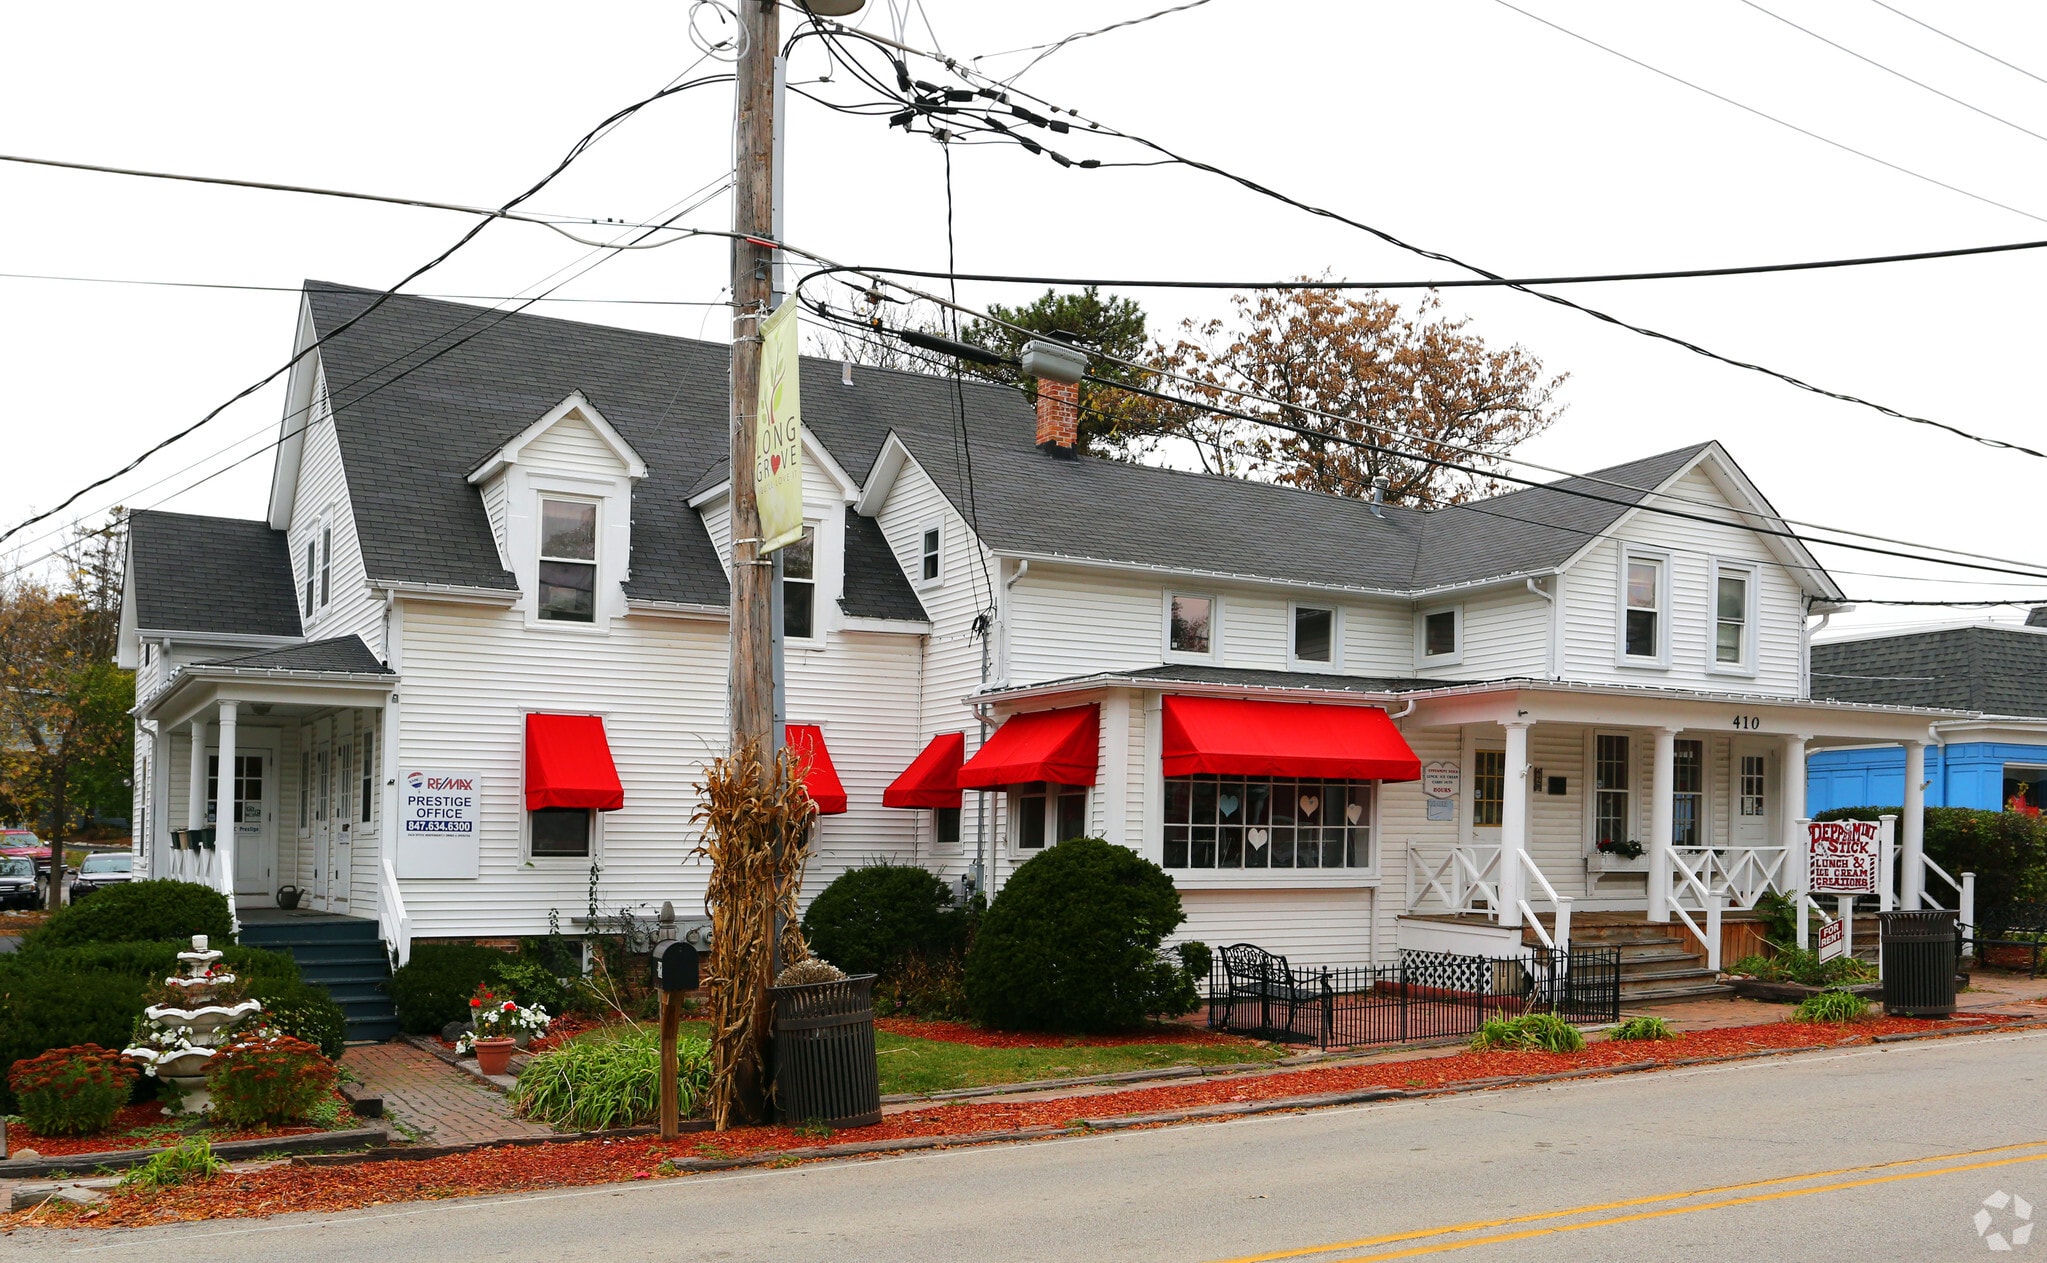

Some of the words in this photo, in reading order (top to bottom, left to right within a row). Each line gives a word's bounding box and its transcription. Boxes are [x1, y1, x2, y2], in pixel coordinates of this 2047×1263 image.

[757, 416, 796, 460] LONG
[1733, 715, 1760, 730] 410
[427, 777, 473, 791] RE/MAX
[408, 796, 471, 807] PRESTIGE
[416, 808, 462, 818] OFFICE
[408, 821, 471, 831] 847.634.6300
[1808, 822, 1878, 853] PEPPERMINT
[1827, 839, 1869, 854] STICK
[1815, 858, 1849, 868] LUNCH
[1853, 856, 1865, 868] &
[1815, 868, 1829, 877] ICE
[1834, 869, 1868, 878] CREAM
[1816, 877, 1869, 887] CREATIONS
[1823, 923, 1839, 938] FOR
[1821, 932, 1842, 948] RENT
